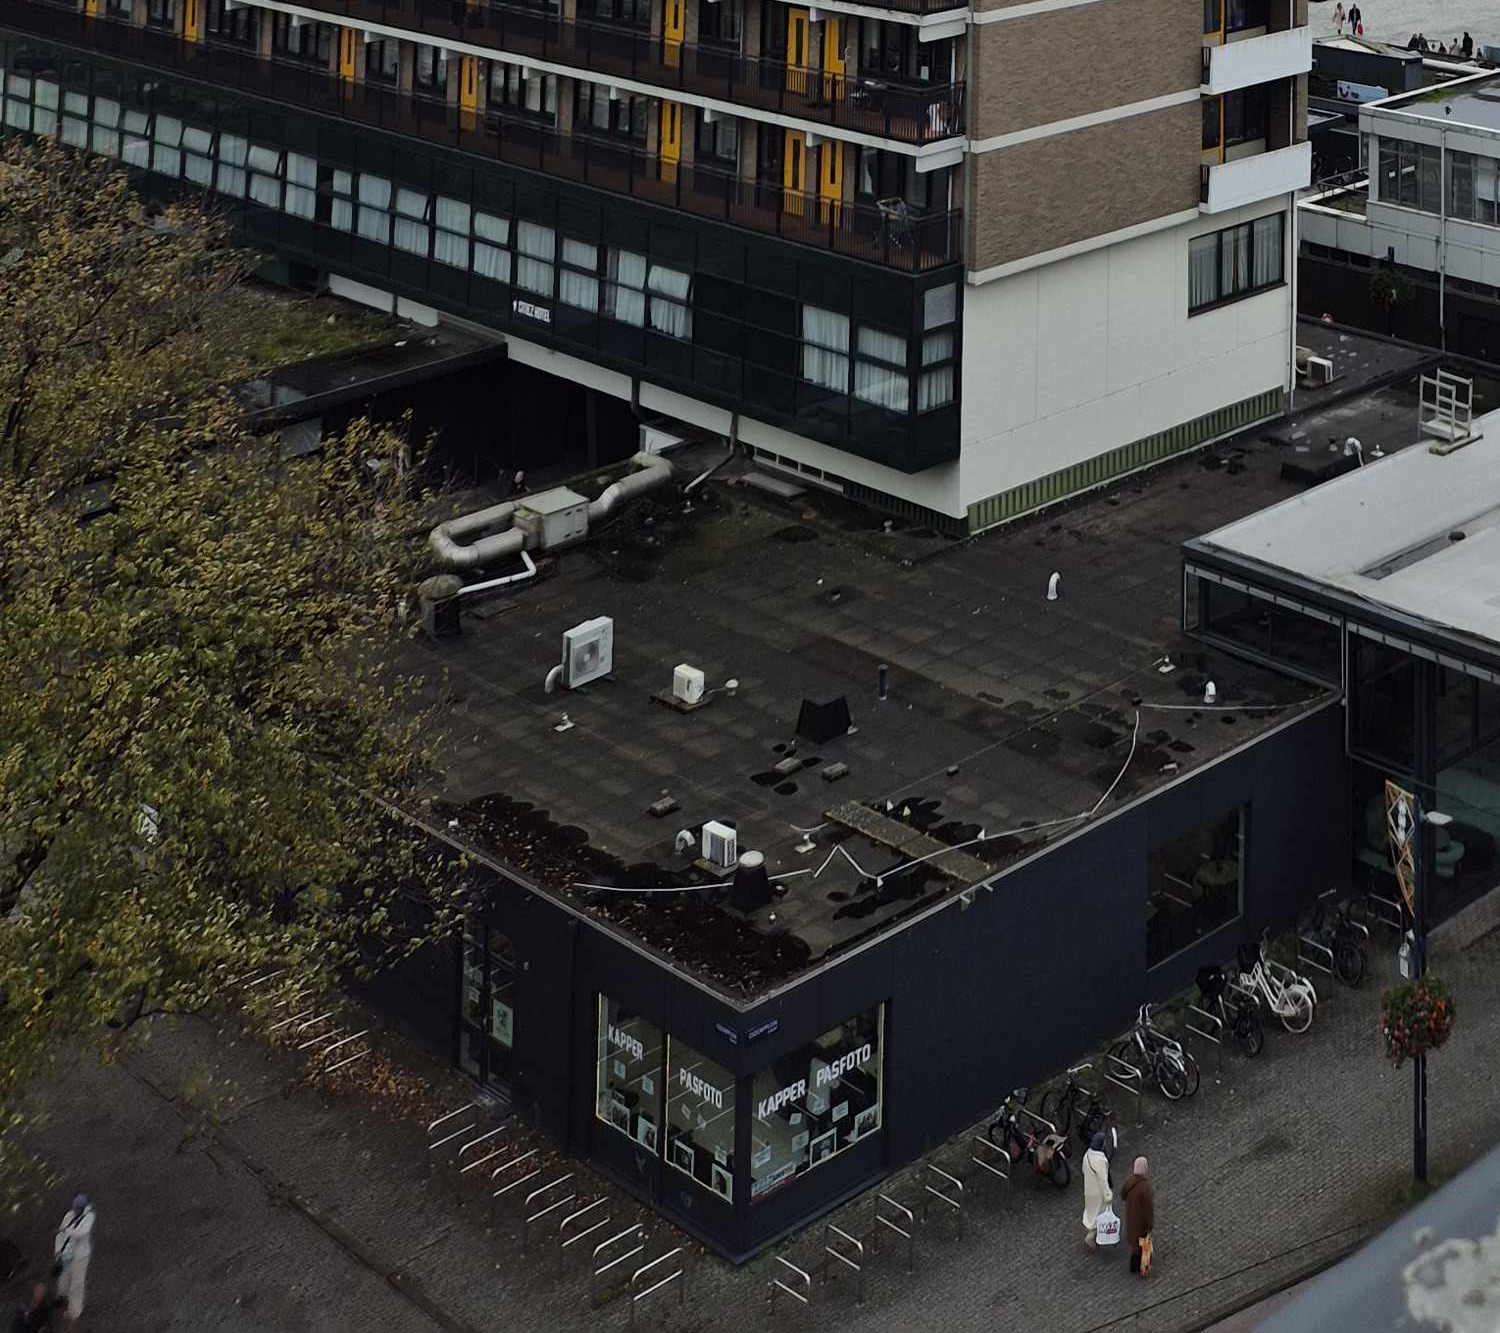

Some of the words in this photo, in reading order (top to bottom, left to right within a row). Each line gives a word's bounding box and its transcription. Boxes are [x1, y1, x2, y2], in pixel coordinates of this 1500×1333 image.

[608, 1023, 643, 1061] KAPPER
[679, 1067, 723, 1109] PASFOTO
[757, 1079, 806, 1120] KAPPER
[816, 1043, 871, 1087] PASFOTO
